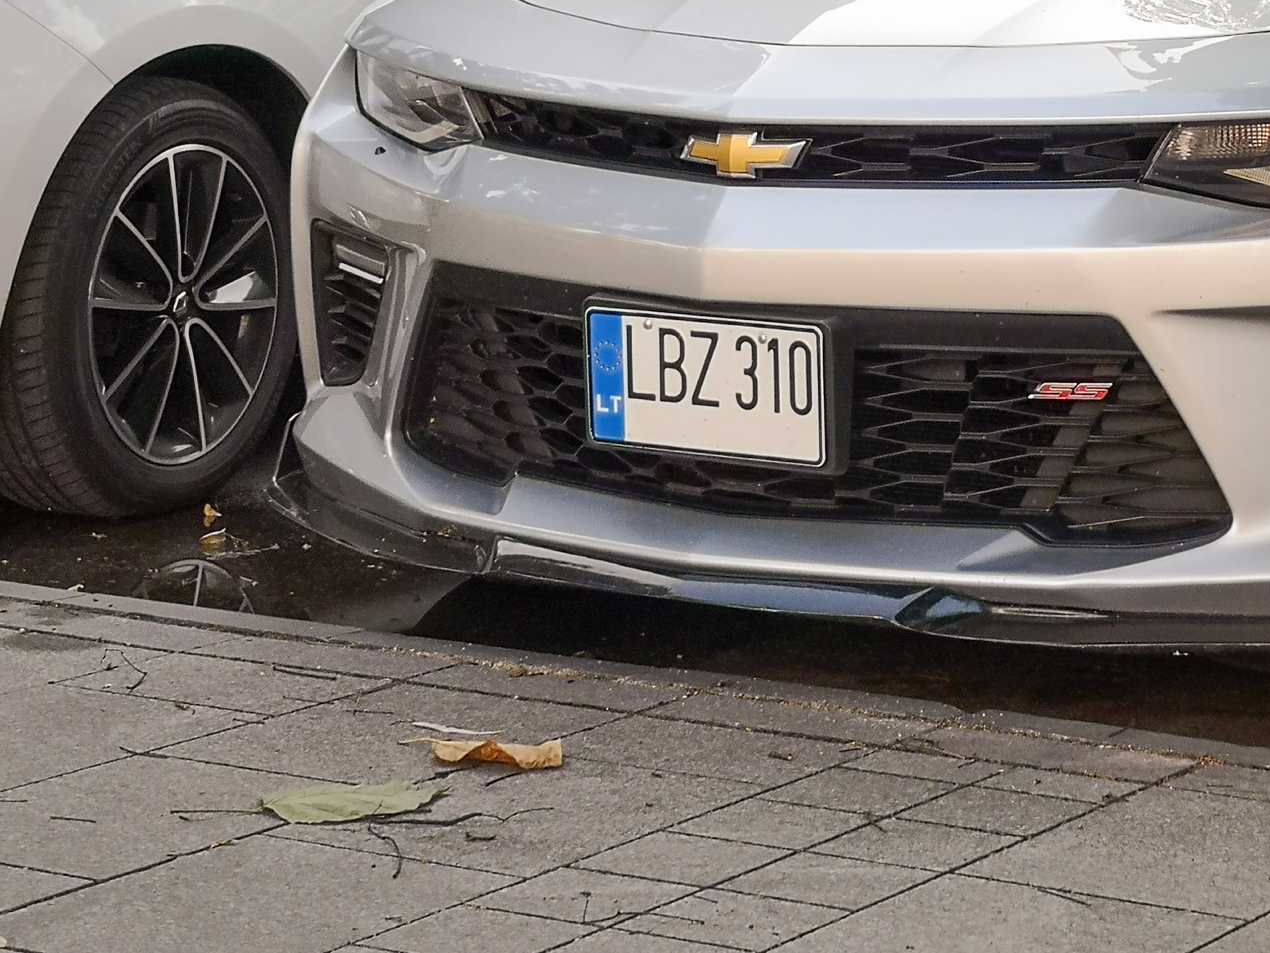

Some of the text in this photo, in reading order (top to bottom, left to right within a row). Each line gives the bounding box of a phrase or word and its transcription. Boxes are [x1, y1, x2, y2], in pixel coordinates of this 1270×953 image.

[626, 324, 813, 416] LBZ 310
[1028, 382, 1113, 400] SS
[597, 394, 621, 413] LT
